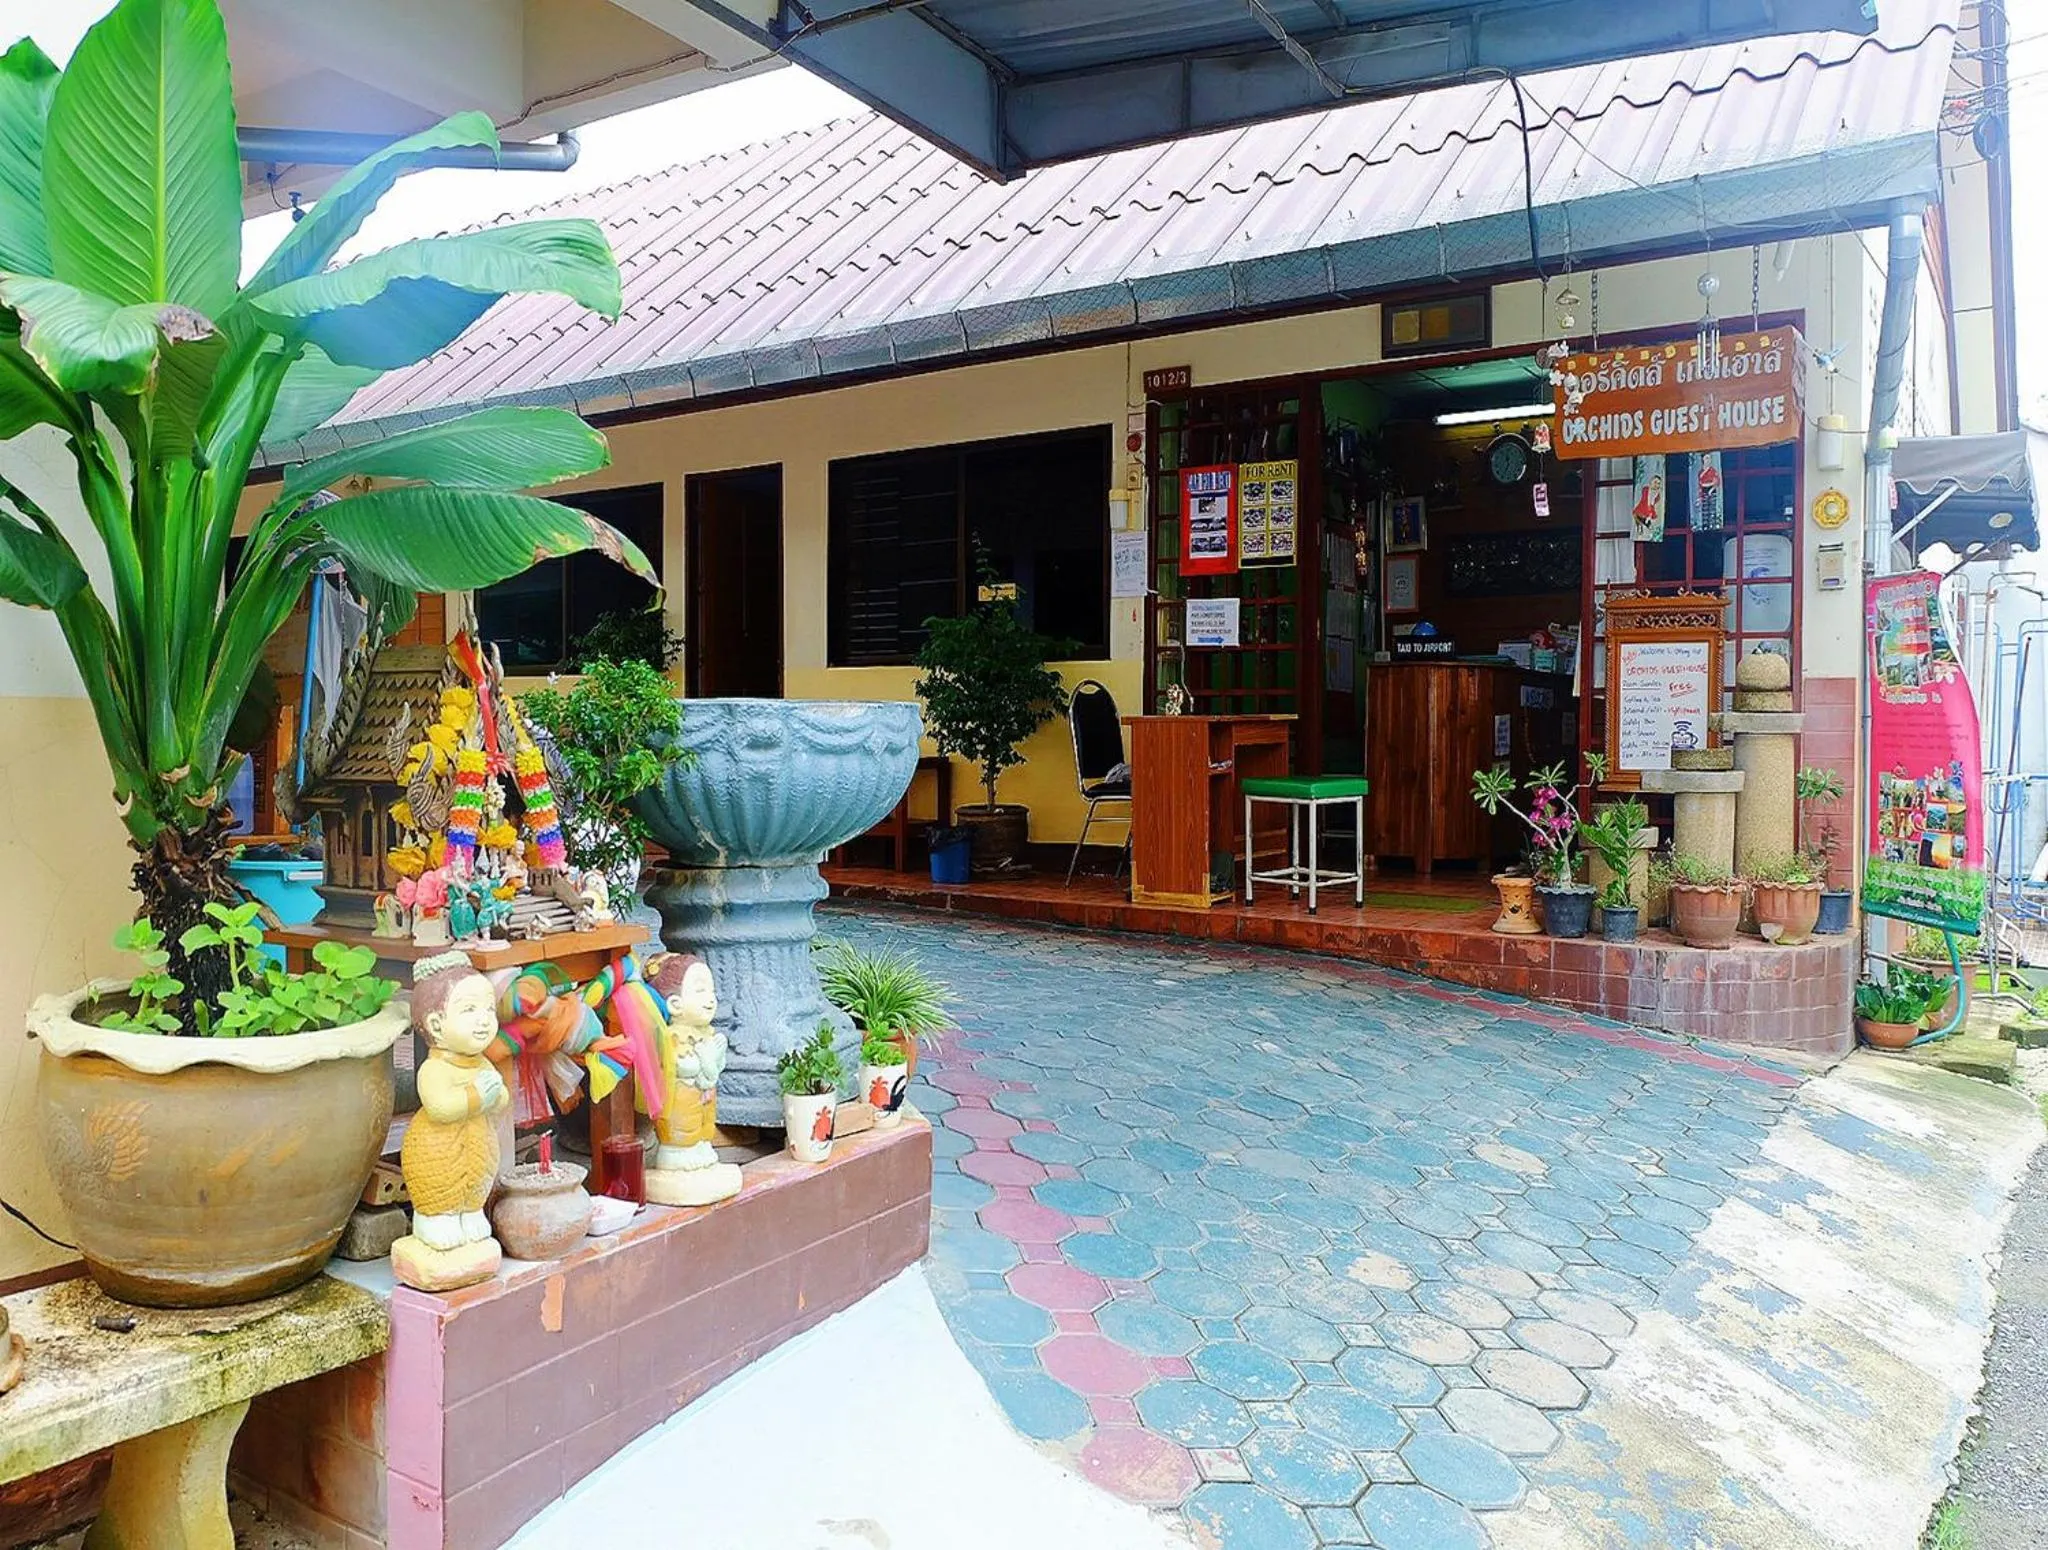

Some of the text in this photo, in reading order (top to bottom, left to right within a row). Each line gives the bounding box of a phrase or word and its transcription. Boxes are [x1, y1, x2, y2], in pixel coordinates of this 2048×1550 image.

[1147, 371, 1186, 388] 1012/3
[1562, 395, 1785, 445] ORCHIDS GUEST HOUSE
[1246, 462, 1294, 479] FOR RENT
[1413, 643, 1423, 653] TO
